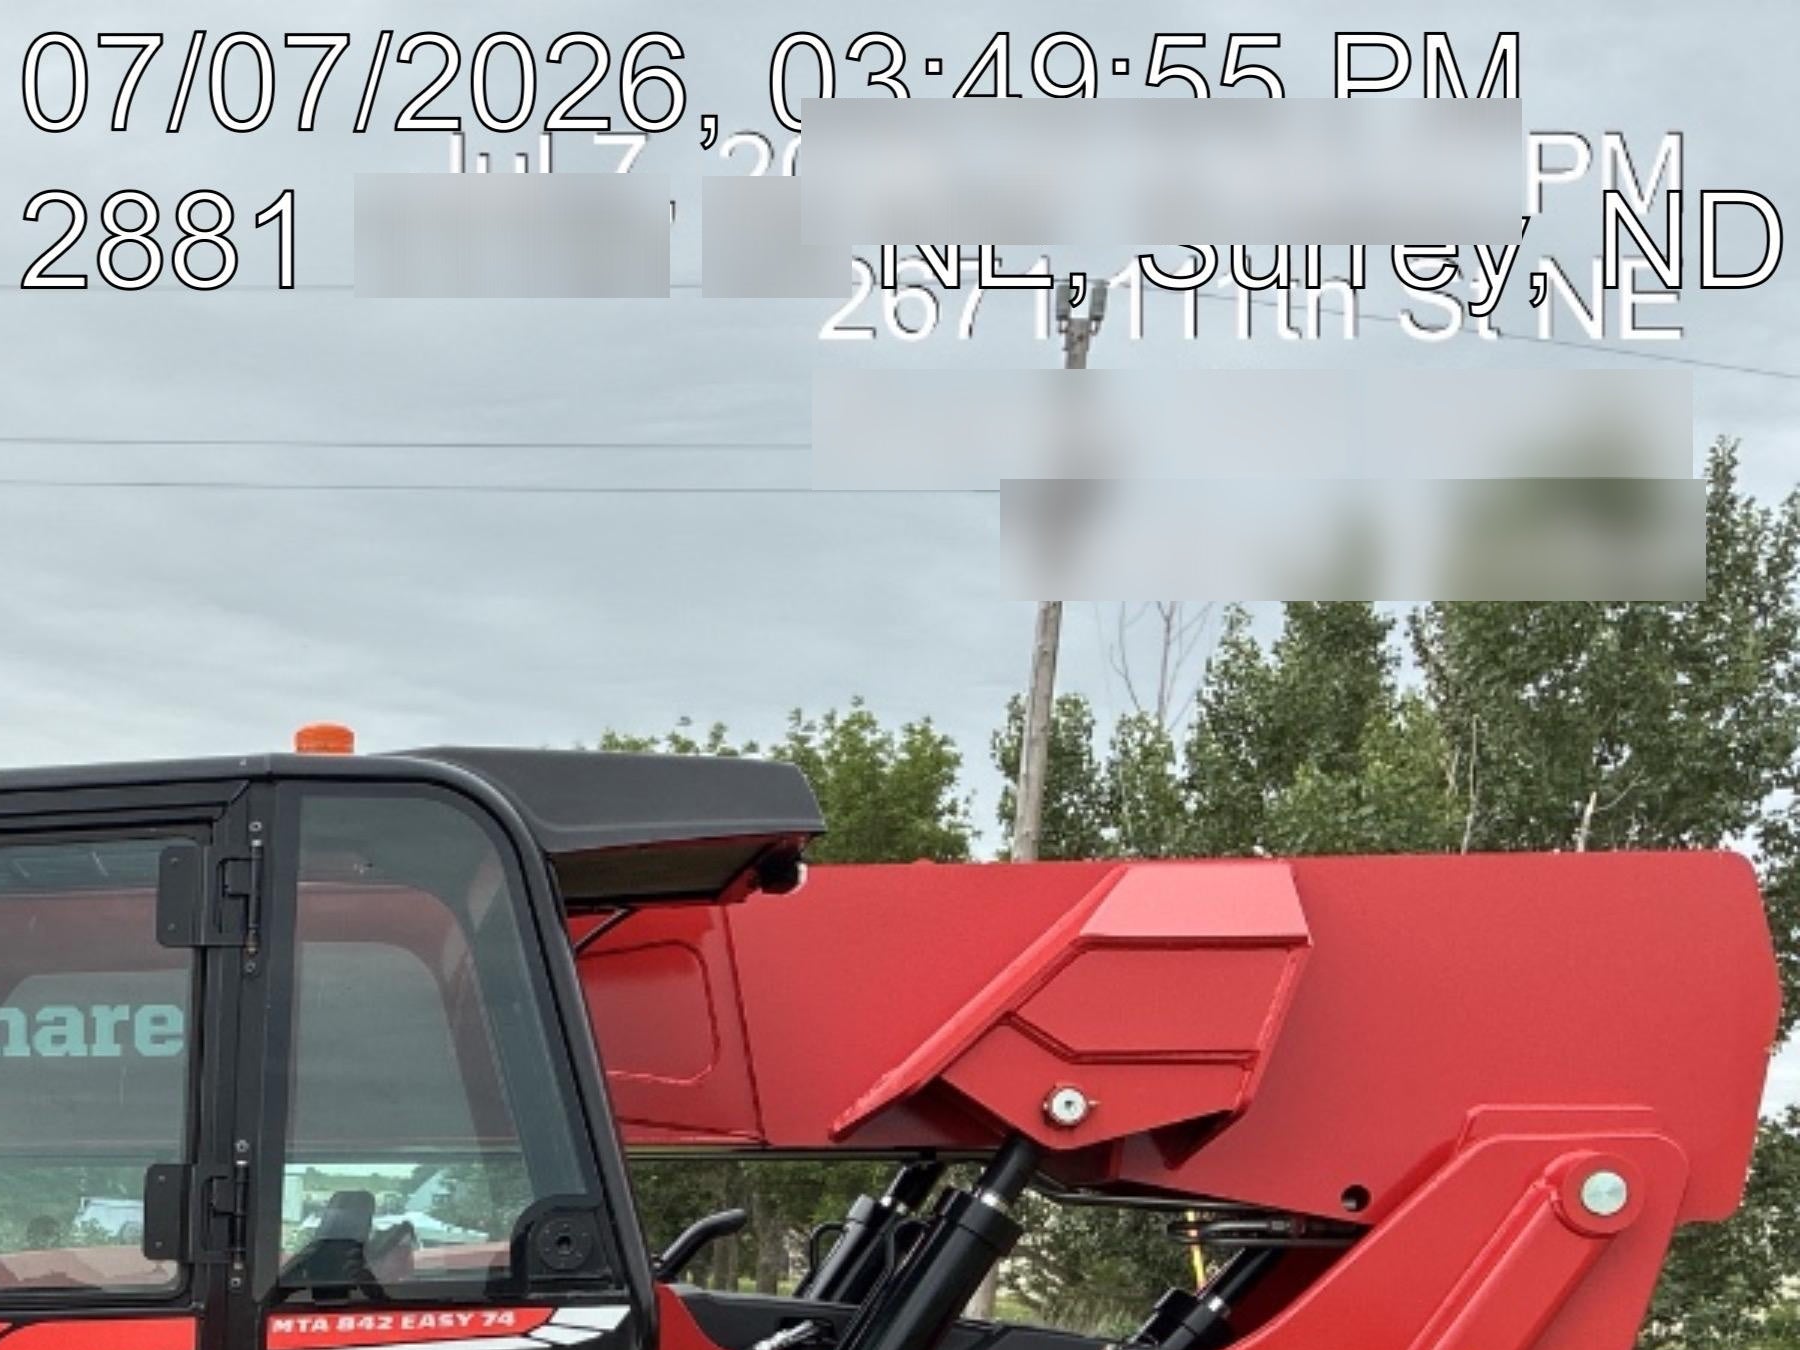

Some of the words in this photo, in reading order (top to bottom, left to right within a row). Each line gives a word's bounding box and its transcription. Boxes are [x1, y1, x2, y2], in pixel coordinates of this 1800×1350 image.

[272, 1318, 329, 1334] MTA
[336, 1316, 394, 1331] 842
[400, 1312, 475, 1331] EASY
[481, 1310, 516, 1327] 74
